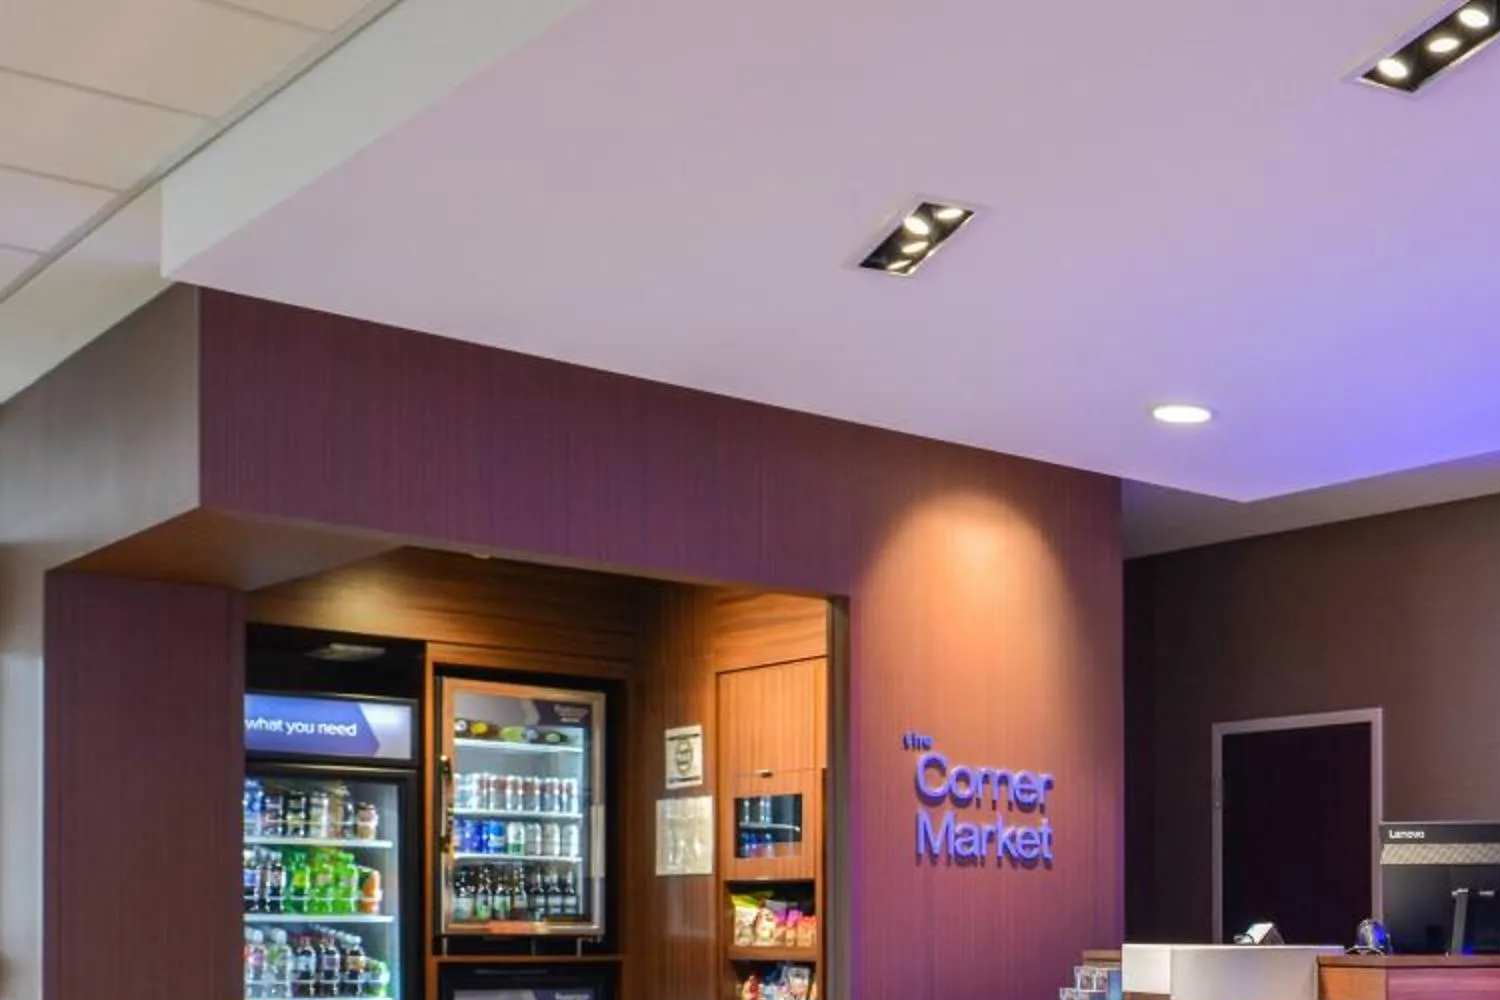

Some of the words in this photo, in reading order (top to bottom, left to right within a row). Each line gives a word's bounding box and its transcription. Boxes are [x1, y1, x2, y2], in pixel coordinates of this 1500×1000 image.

[244, 716, 283, 732] what
[284, 720, 315, 736] you
[317, 722, 357, 737] need
[903, 731, 933, 751] the
[915, 752, 1054, 813] Corner
[915, 808, 1054, 870] Market
[1388, 829, 1425, 839] Lenovo
